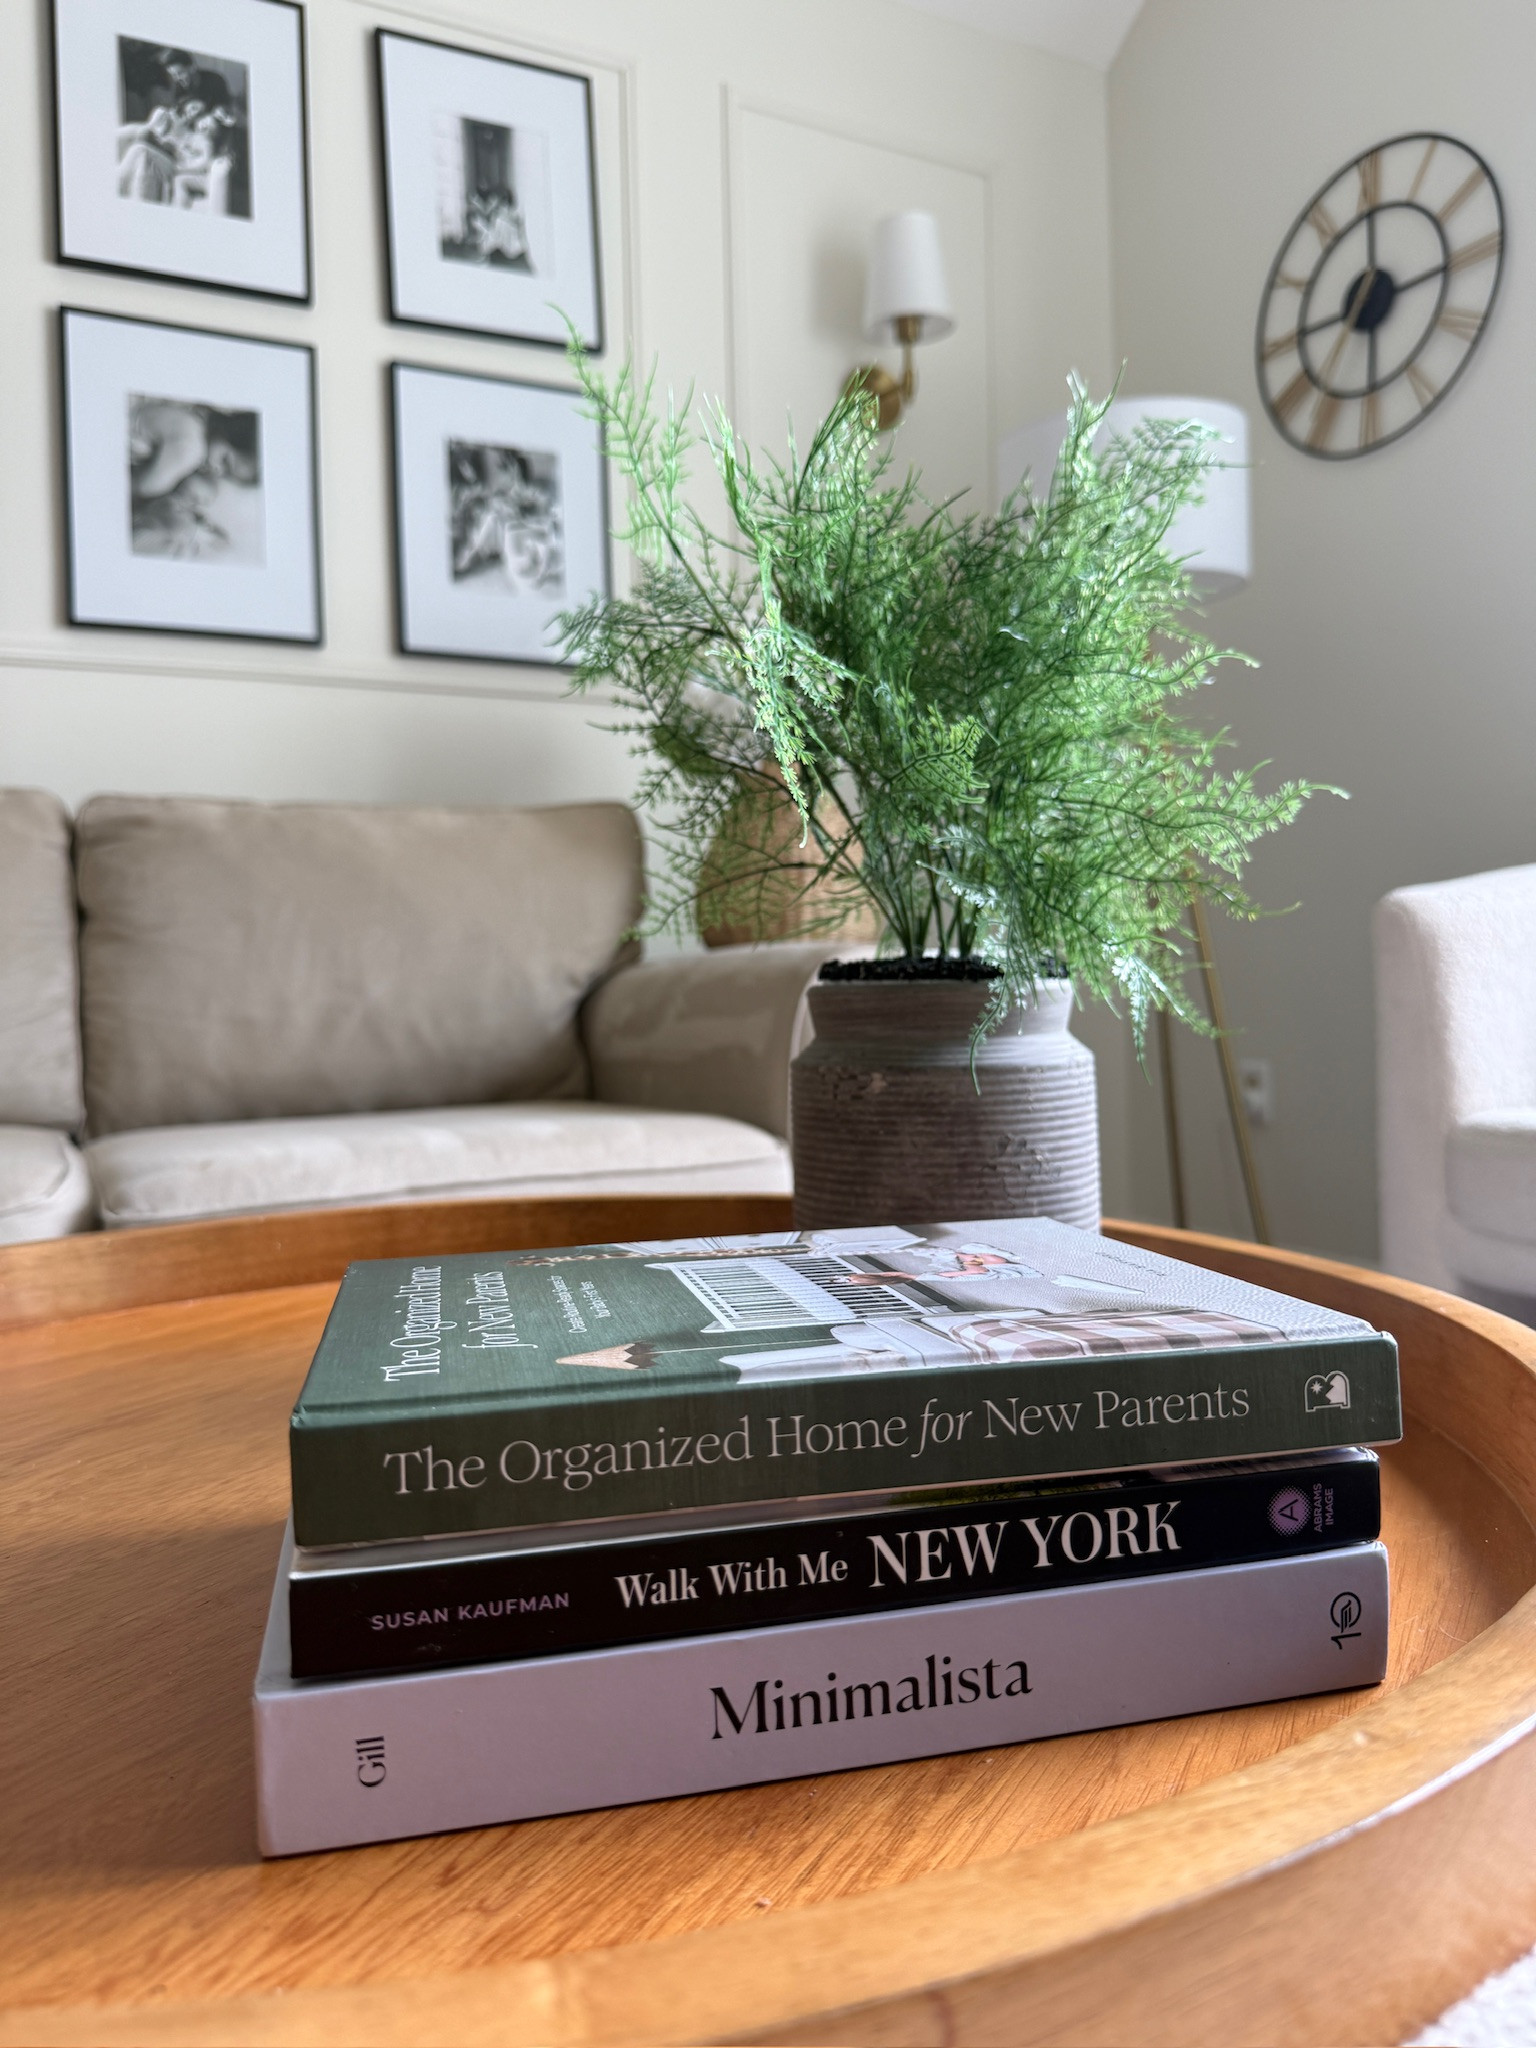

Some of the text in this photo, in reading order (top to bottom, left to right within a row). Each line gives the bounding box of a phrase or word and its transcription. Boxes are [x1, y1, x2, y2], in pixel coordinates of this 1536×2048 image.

[380, 1266, 458, 1382] The Organized Home
[461, 1271, 538, 1349] for New Parents
[383, 1383, 1250, 1495] The Organized Home for New Parents
[1313, 1483, 1323, 1533] ABRAMS
[1325, 1487, 1334, 1526] IMAGE
[614, 1500, 1182, 1608] Walk With Me NEW YORK
[371, 1592, 570, 1632] SUSAN KAUFMAN
[710, 1655, 1033, 1740] Minimalista
[355, 1735, 387, 1788] Gill
